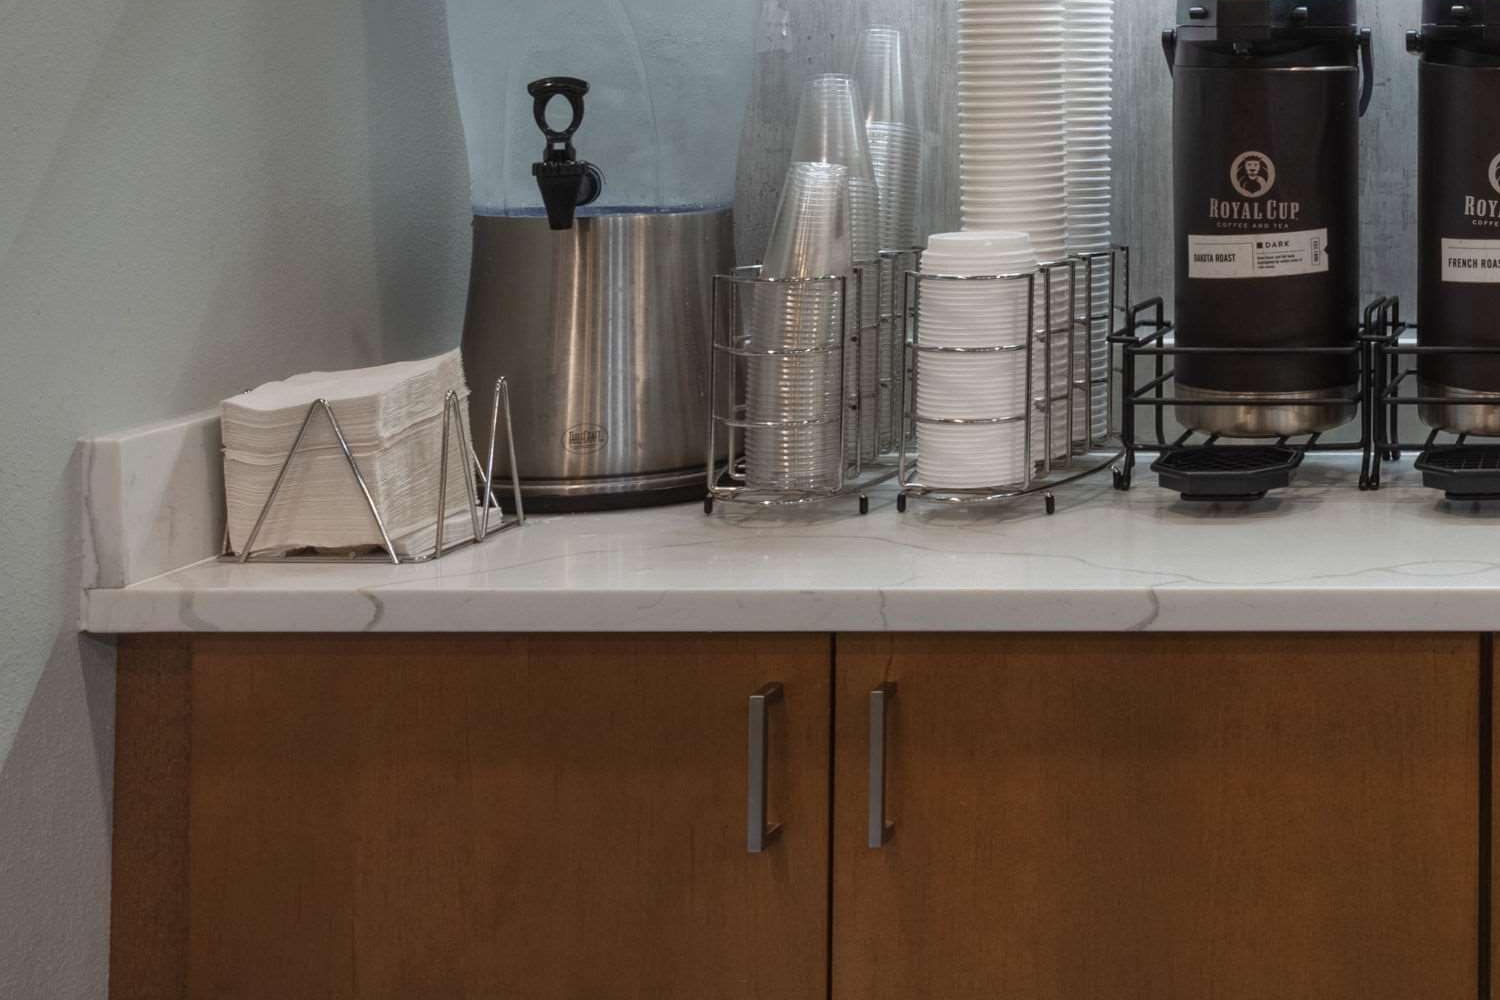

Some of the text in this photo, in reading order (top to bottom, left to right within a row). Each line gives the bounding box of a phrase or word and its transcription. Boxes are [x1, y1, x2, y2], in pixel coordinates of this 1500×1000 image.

[1209, 198, 1300, 220] ROYAL CUP
[1265, 240, 1289, 249] DARK
[1215, 252, 1236, 263] ROAST
[1448, 258, 1478, 269] FRENCH
